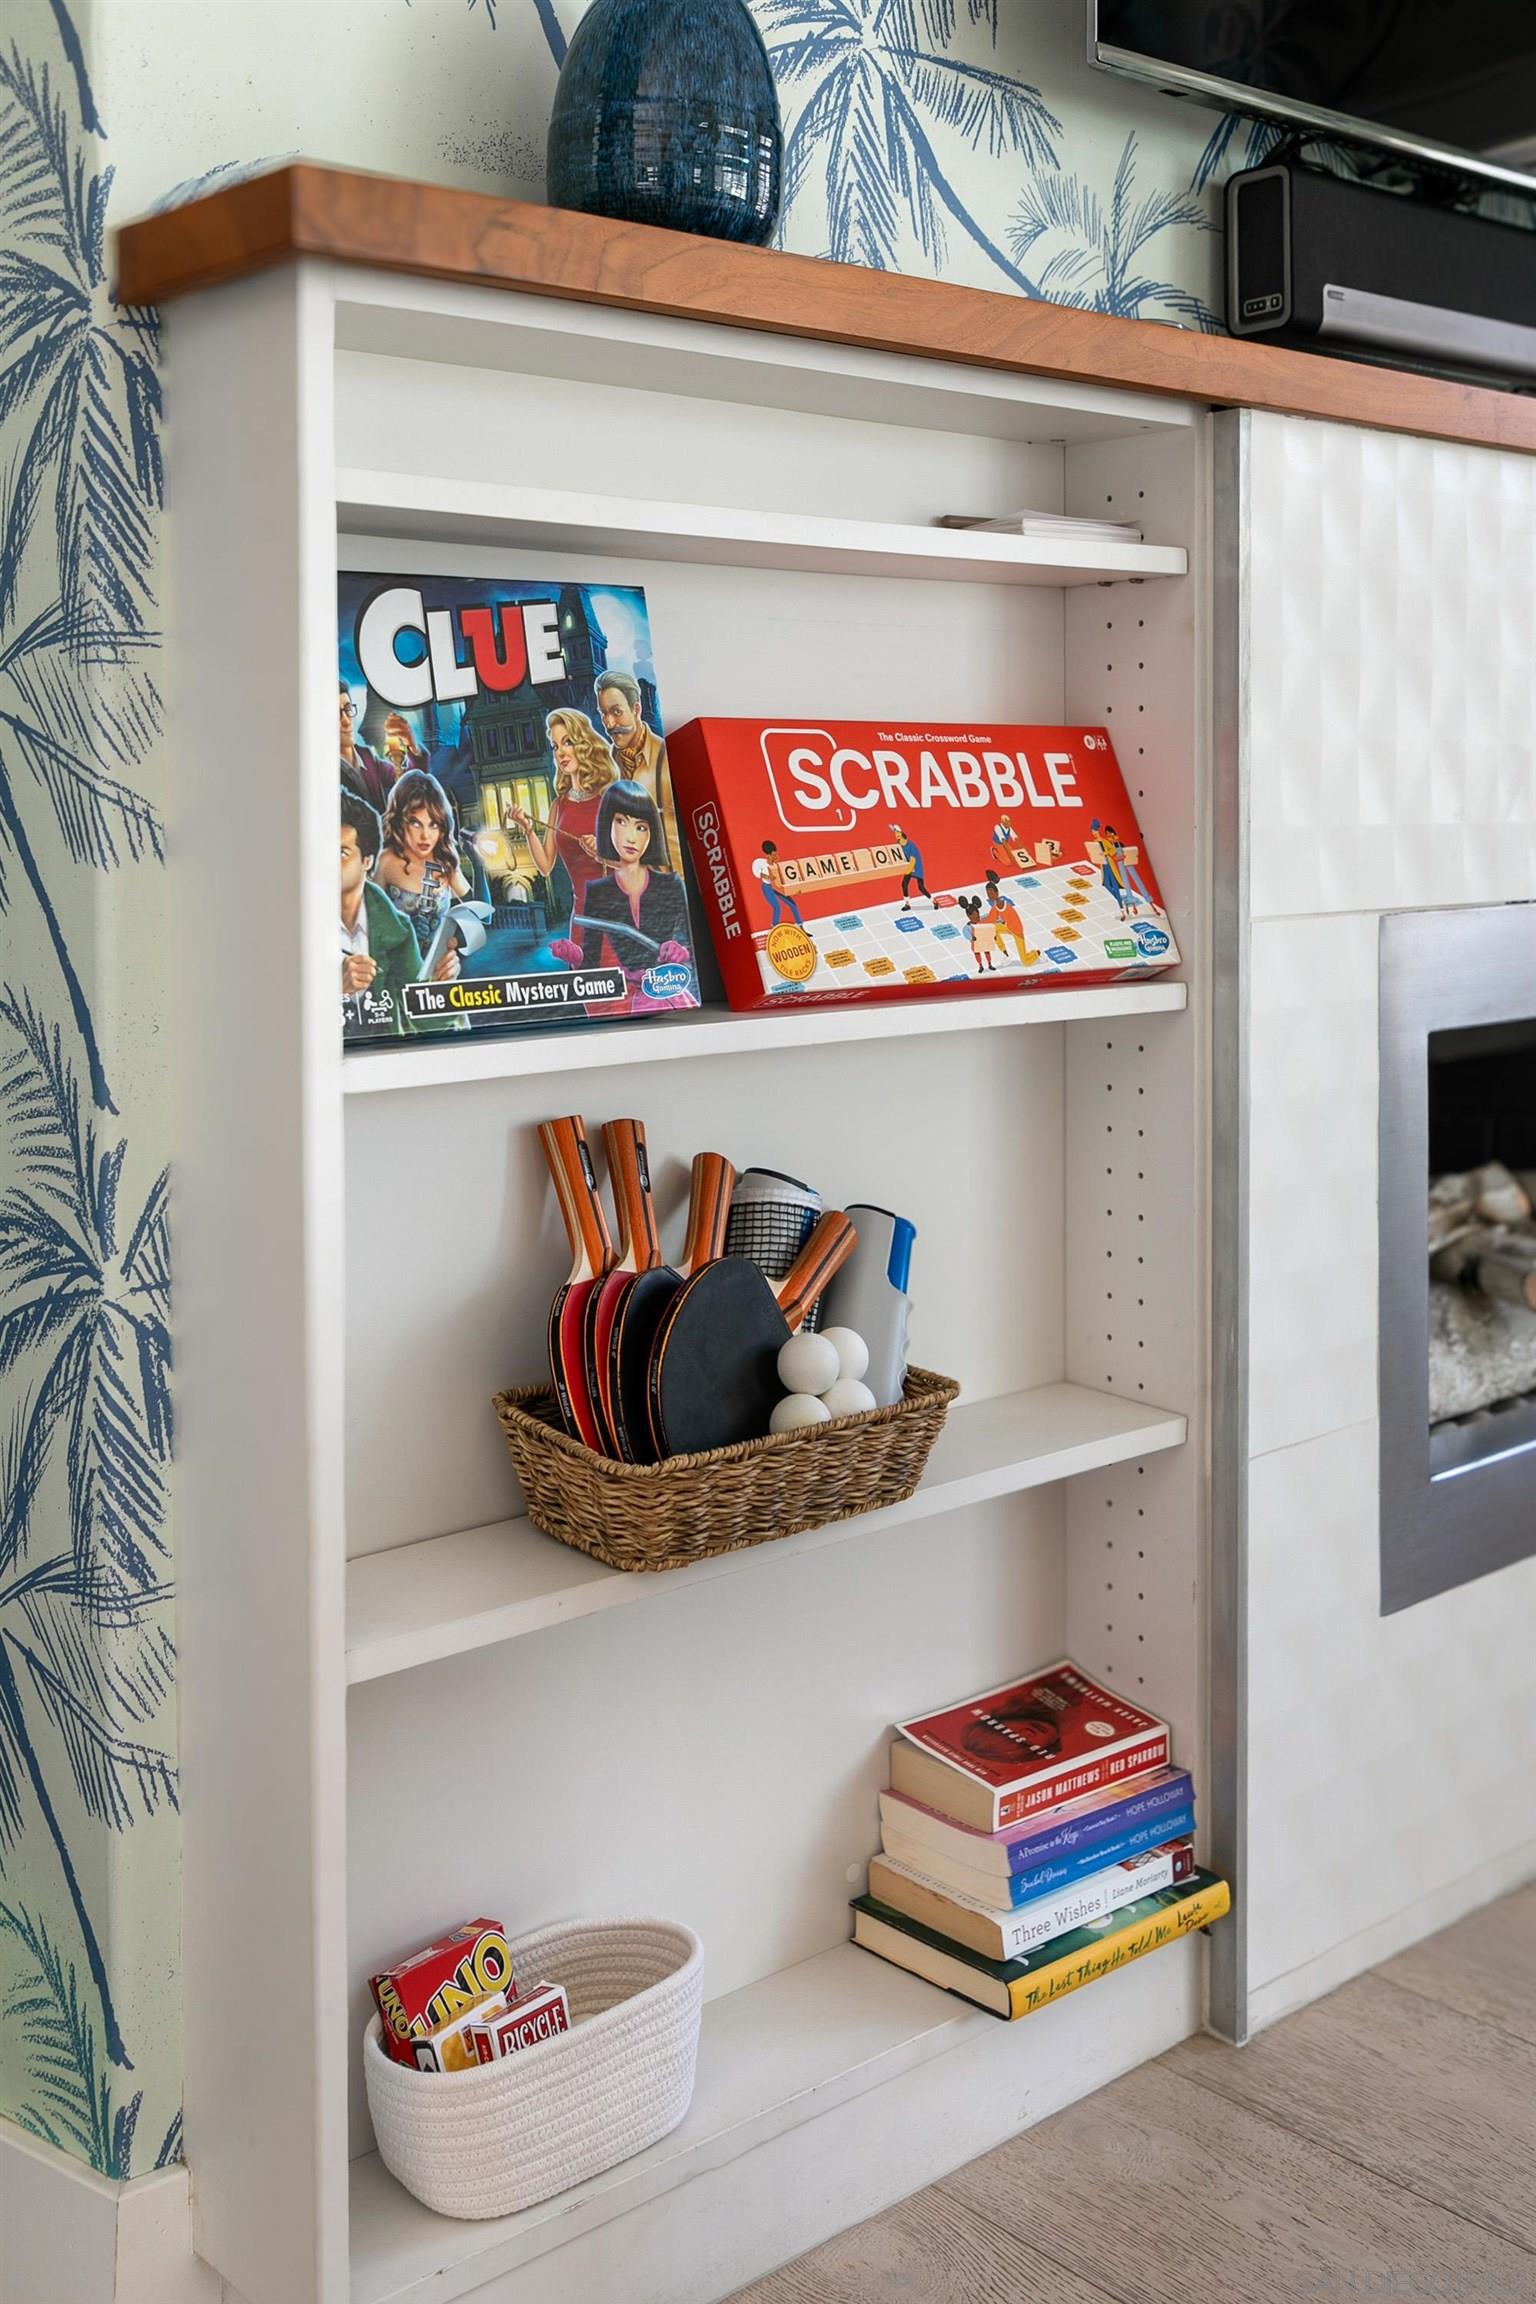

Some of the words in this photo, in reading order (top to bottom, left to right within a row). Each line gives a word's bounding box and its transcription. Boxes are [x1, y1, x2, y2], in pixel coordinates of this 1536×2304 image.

[358, 587, 567, 707] CLUE
[877, 732, 893, 742] The
[895, 732, 924, 742] Classic
[925, 733, 968, 743] Crossword
[968, 734, 992, 744] Game
[787, 748, 1084, 809] SCRABBLE
[836, 809, 843, 821] 1
[698, 811, 741, 940] SCRABBLE
[785, 857, 851, 880] GAME
[876, 847, 903, 864] ON
[784, 928, 803, 940] WITH
[1138, 933, 1168, 946] Hasbro
[772, 943, 811, 963] WOODEN
[644, 968, 686, 985] Hasbro
[780, 964, 793, 976] TILE
[415, 987, 446, 1011] The
[449, 984, 503, 1009] Classic
[505, 980, 569, 1005] Mystery
[573, 976, 615, 998] Game
[652, 983, 683, 994] Gaming
[1025, 1787, 1053, 1808] JASON
[1055, 1769, 1100, 1796] MATTHEWS
[1110, 1759, 1125, 1775] RED
[1128, 1743, 1166, 1769] SPARROW
[1126, 1802, 1147, 1817] HOPE
[1147, 1786, 1184, 1808] HOLLOWAY
[1129, 1830, 1149, 1845] HOPE
[1150, 1814, 1188, 1836] HOLLOWAY
[1012, 1919, 1051, 1946] Three
[1054, 1897, 1101, 1926] Wishes
[1112, 1884, 1134, 1900] Liane
[1135, 1868, 1169, 1890] Moriarty
[1025, 1986, 1047, 2010] The
[1050, 1971, 1074, 1997] Last
[1077, 1959, 1110, 1983] Thing
[1110, 1945, 1125, 1966] He
[377, 1975, 412, 2039] UNO
[502, 2004, 566, 2056] BICYCLE
